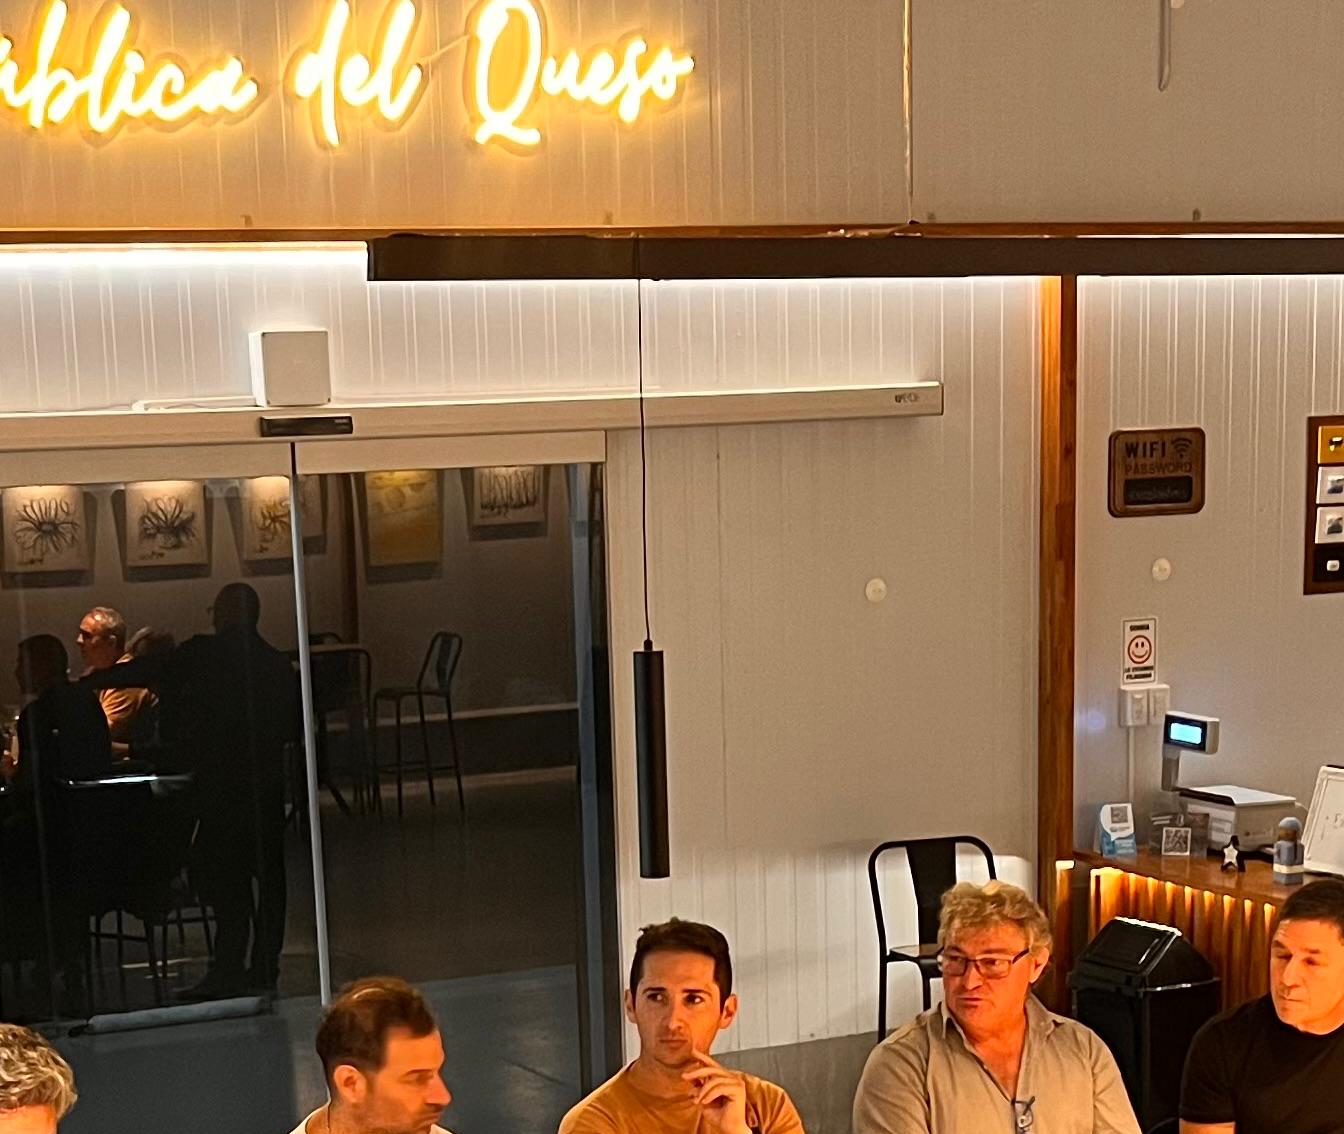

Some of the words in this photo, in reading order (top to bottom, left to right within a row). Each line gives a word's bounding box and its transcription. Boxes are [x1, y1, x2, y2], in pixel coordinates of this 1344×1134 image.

[293, 0, 424, 147] del
[470, 0, 696, 145] Queso
[1124, 440, 1167, 459] WIFI
